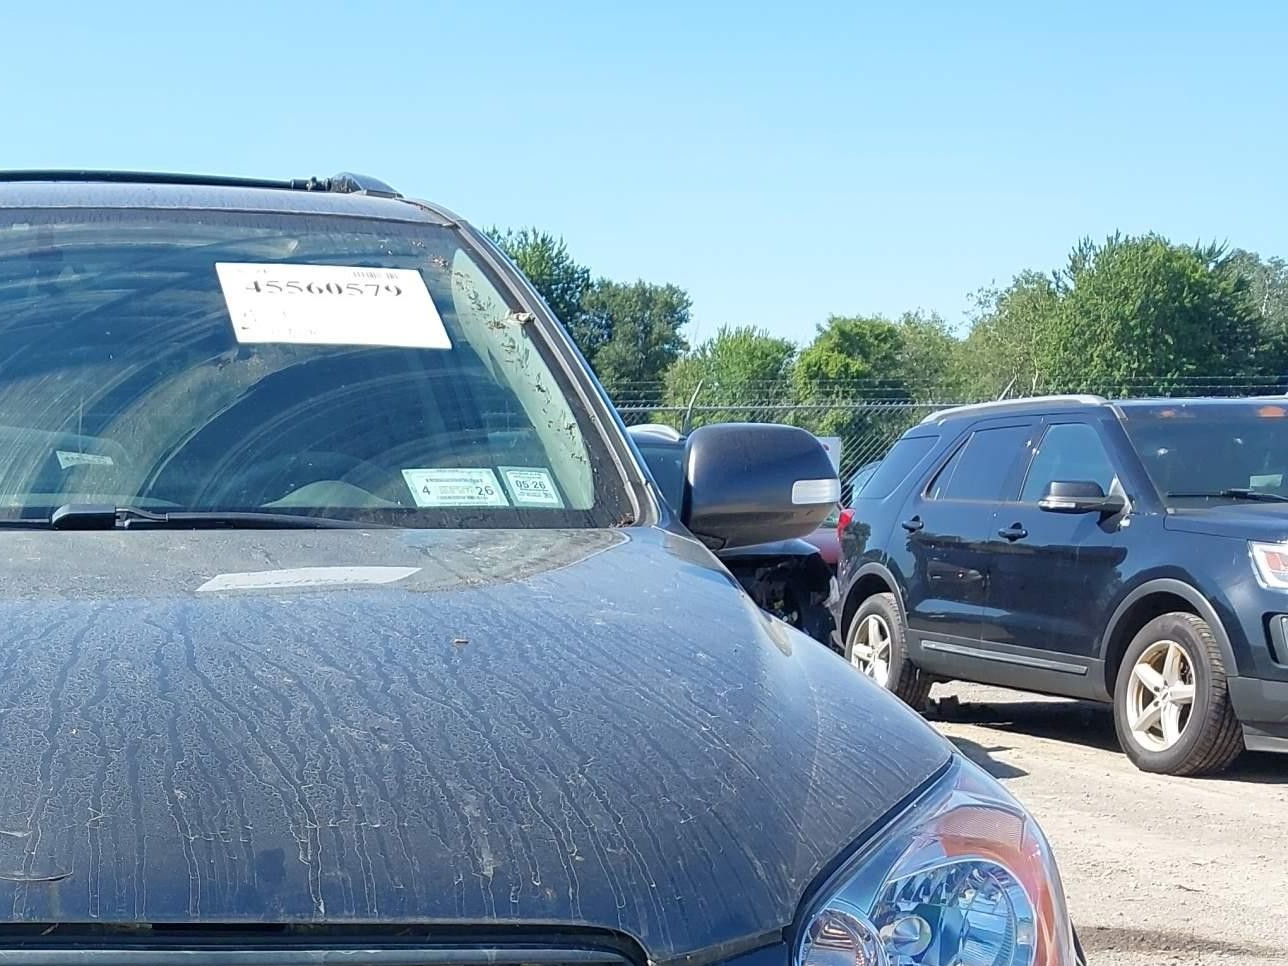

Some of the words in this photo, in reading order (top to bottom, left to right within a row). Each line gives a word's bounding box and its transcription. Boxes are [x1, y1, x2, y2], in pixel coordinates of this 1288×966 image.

[245, 279, 403, 297] 45560579
[422, 485, 431, 495] 4
[476, 485, 495, 496] 26
